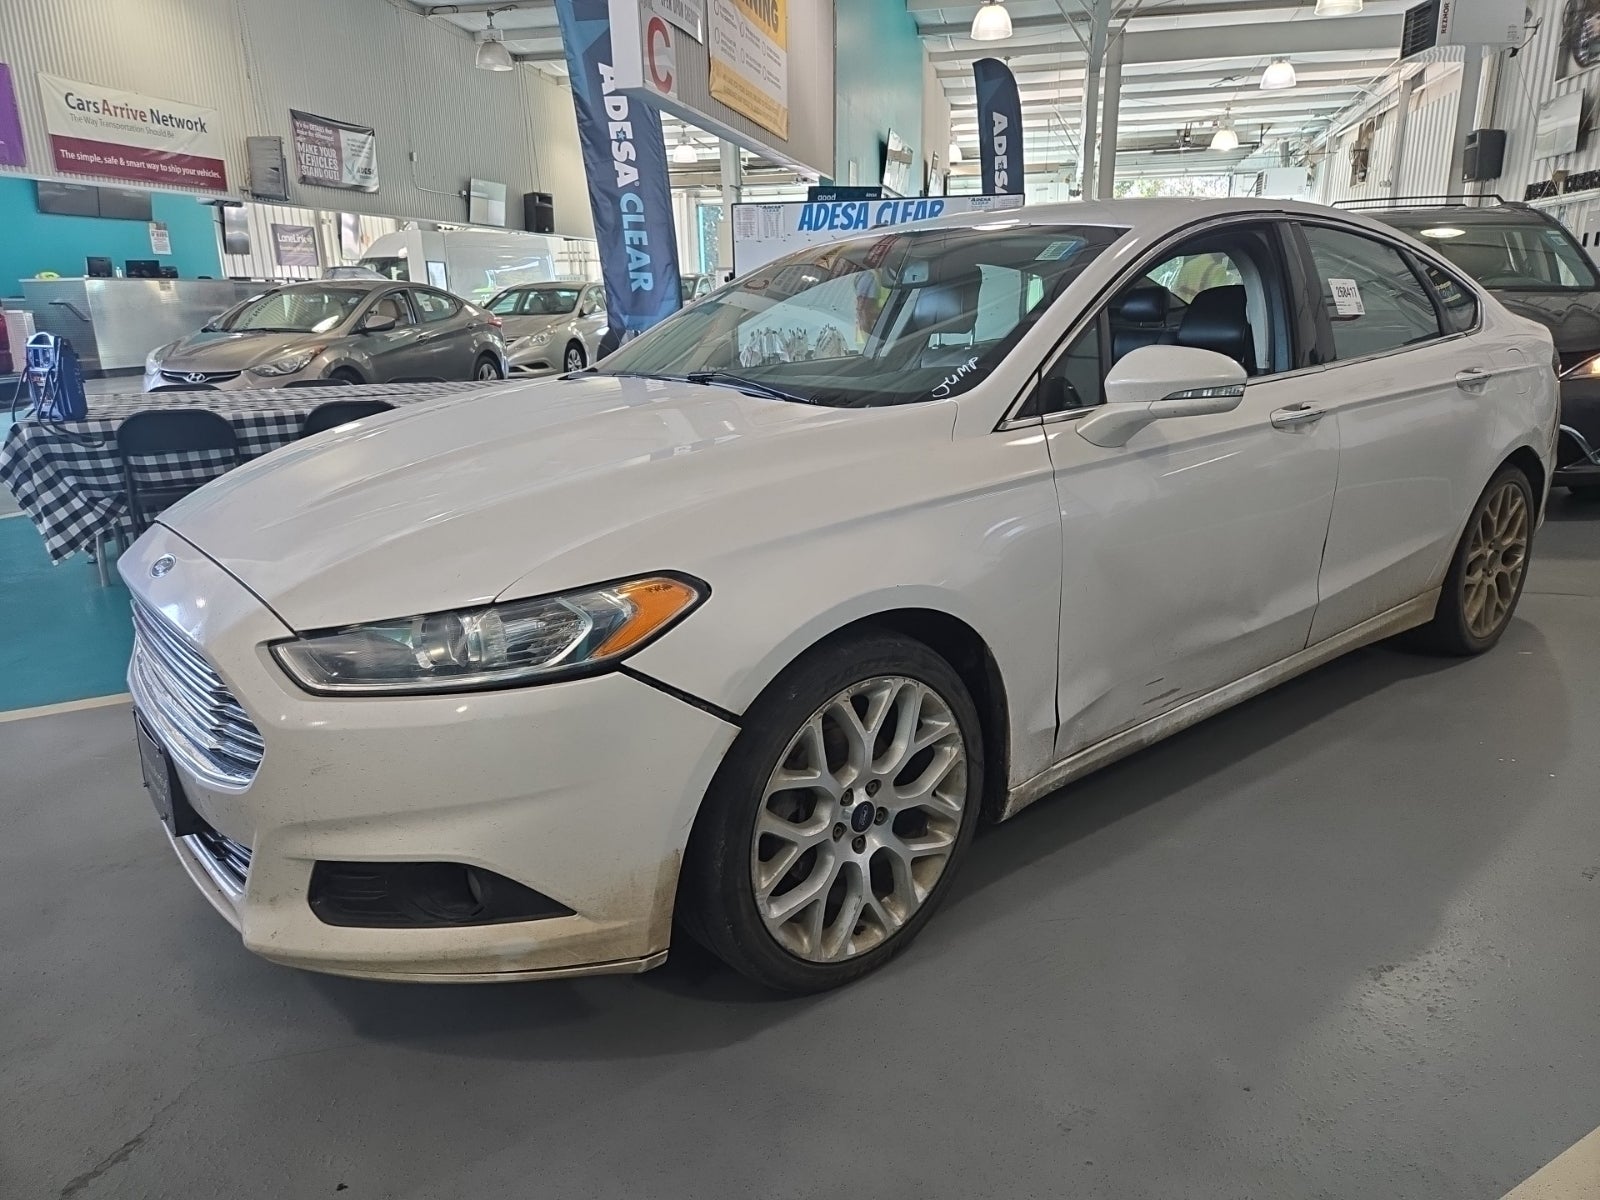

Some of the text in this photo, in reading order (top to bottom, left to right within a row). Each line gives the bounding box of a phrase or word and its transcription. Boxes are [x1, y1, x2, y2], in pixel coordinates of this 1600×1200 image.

[1441, 2, 1450, 34] REZNOR
[647, 16, 673, 95] C
[64, 92, 207, 134] CarsArrive Network
[70, 113, 83, 123] The
[84, 115, 98, 128] Way
[99, 118, 145, 133] Transportation
[145, 126, 167, 137] Should
[60, 149, 221, 178] The simple, safe & smart way to ship your vehicles.
[297, 141, 319, 154] MAKE
[319, 146, 337, 159] YOUR
[299, 152, 339, 171] VEHICLES
[301, 164, 323, 178] STAND
[598, 62, 654, 293] ADESA CLEAR
[797, 202, 870, 232] ADESA
[875, 199, 945, 226] CLEAR
[932, 356, 978, 397] JUMP
